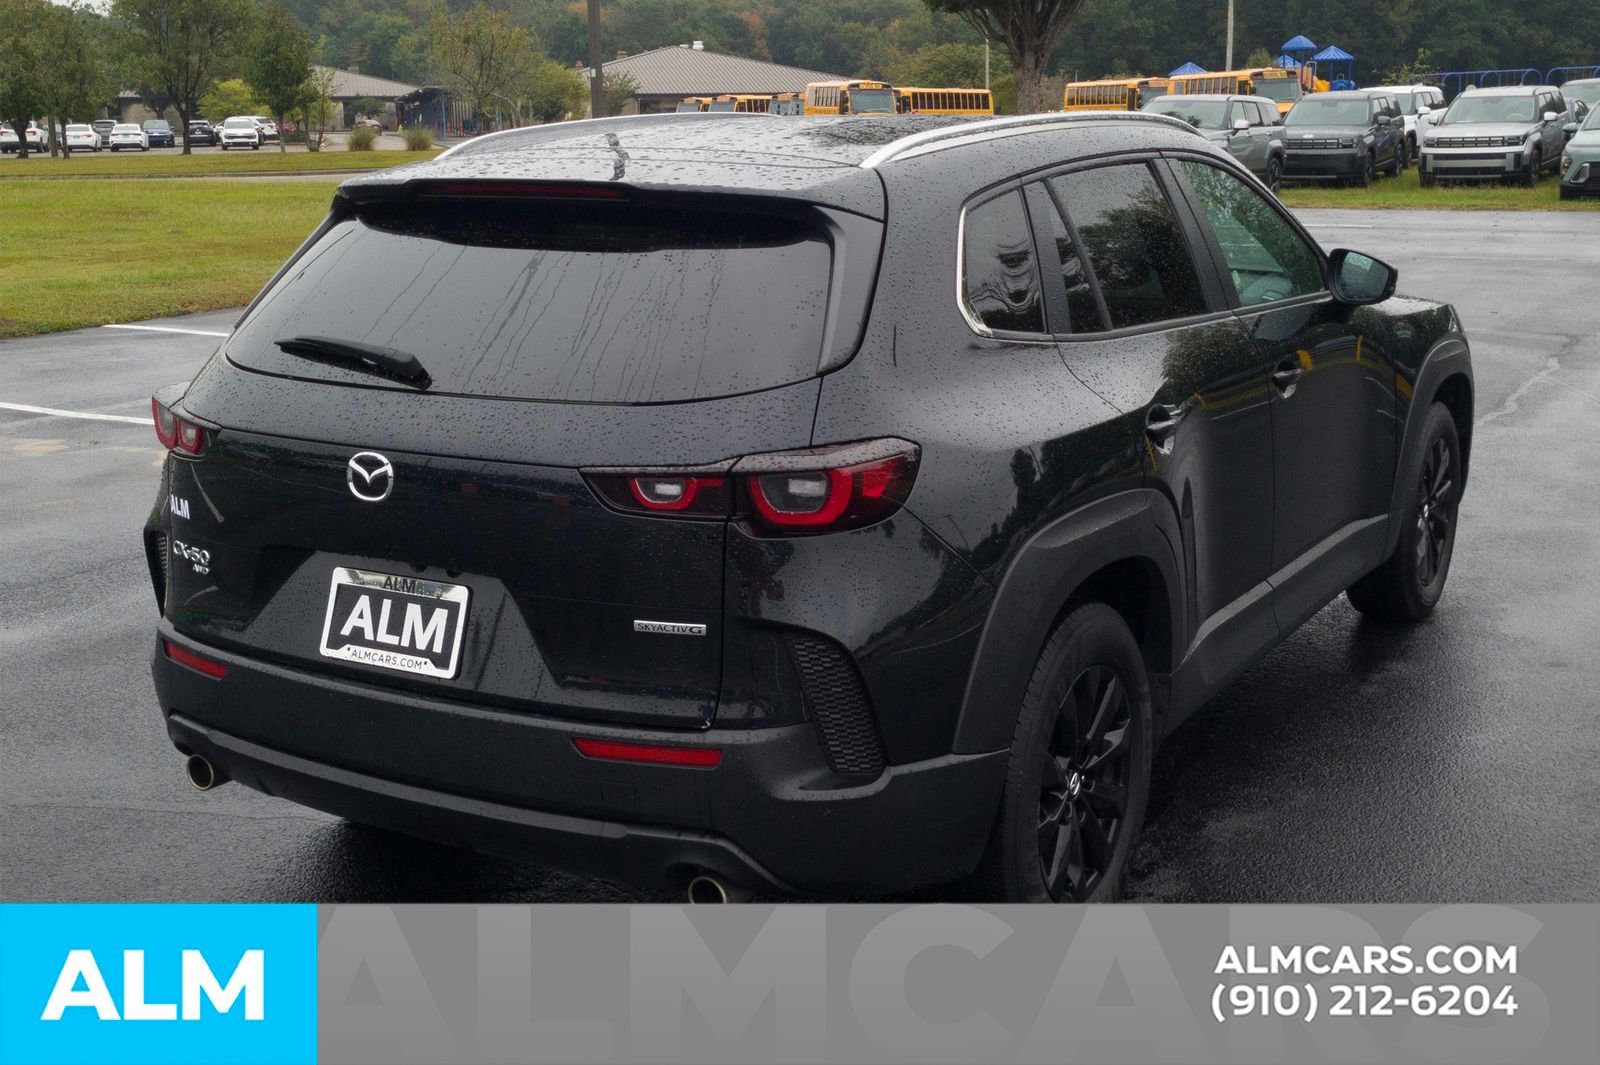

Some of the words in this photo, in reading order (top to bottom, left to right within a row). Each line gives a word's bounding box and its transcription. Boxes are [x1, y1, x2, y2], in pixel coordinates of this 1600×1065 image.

[170, 494, 190, 519] ALM
[383, 576, 416, 594] ALM
[340, 594, 449, 654] ALM
[351, 649, 422, 670] ALMCARS.COM
